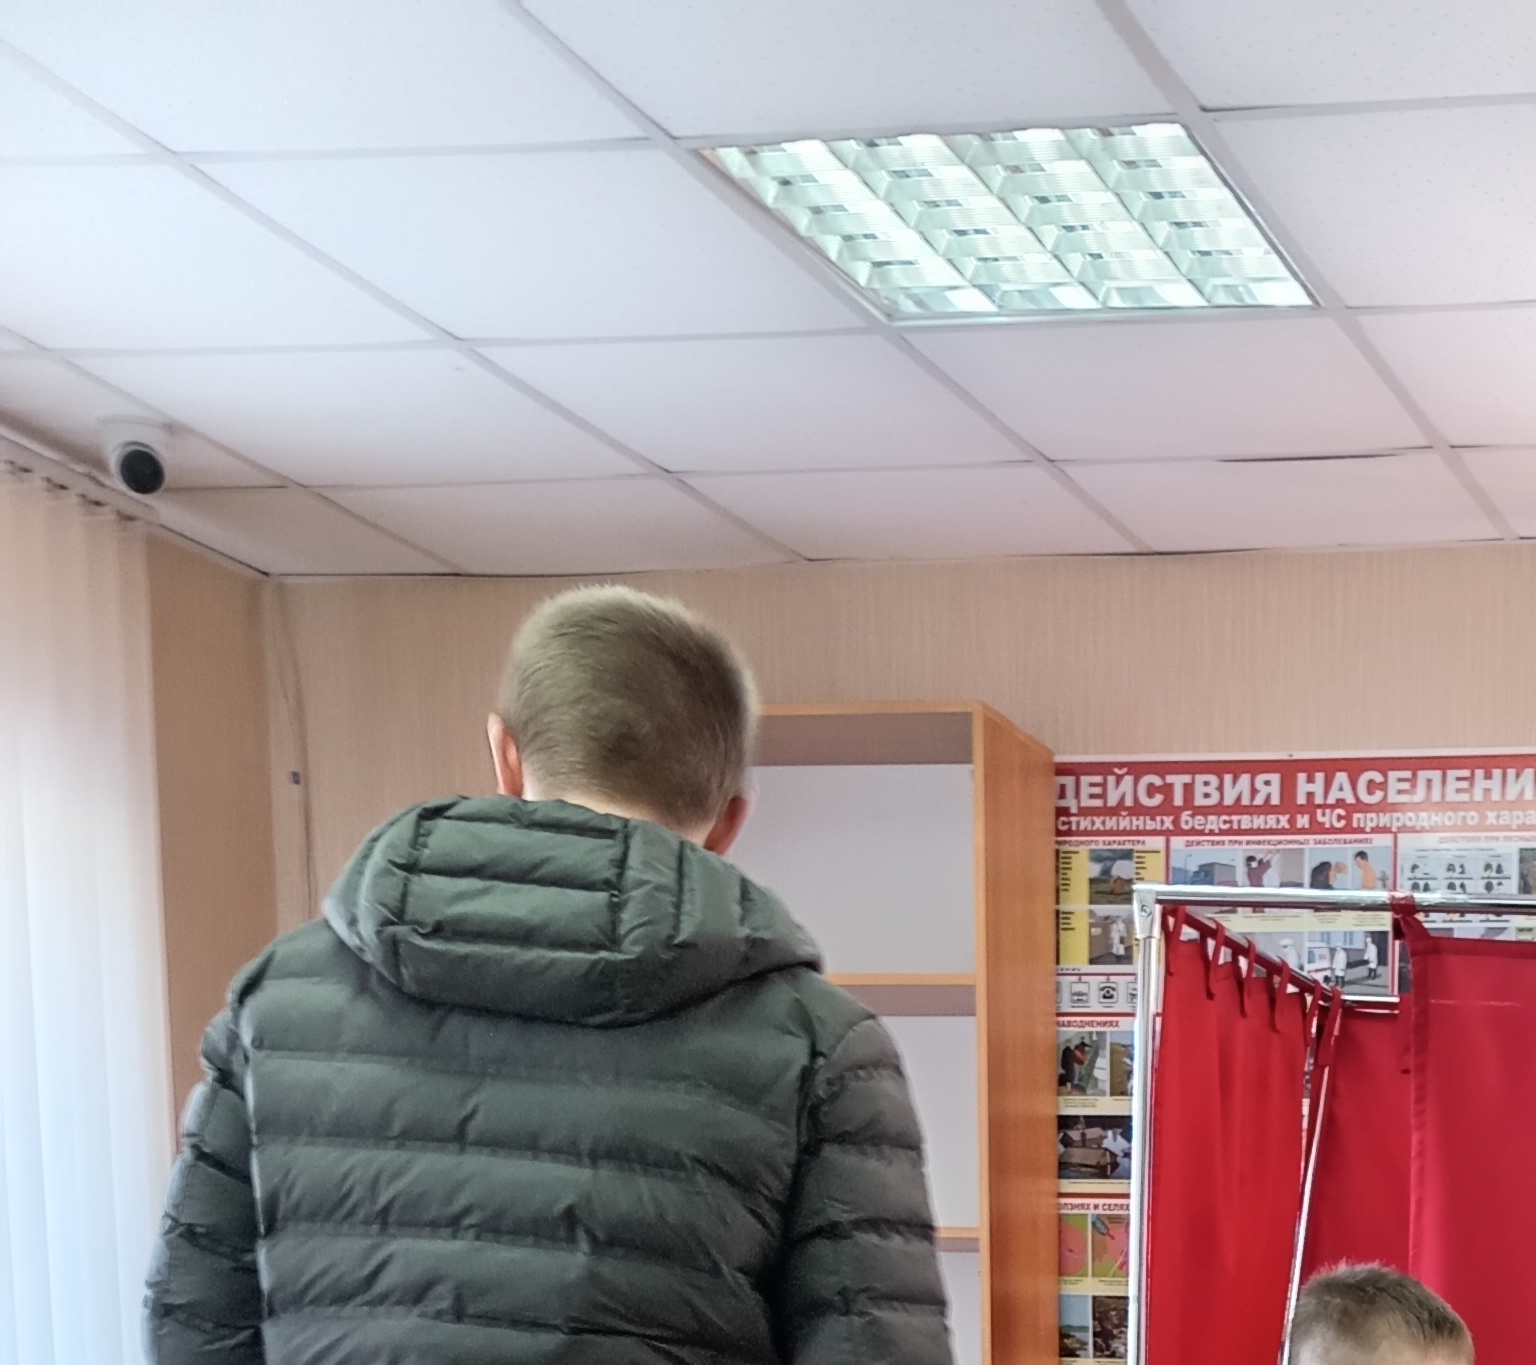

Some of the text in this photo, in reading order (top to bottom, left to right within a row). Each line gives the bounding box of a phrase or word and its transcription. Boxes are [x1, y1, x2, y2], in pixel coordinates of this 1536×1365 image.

[1055, 767, 1281, 813] ДЕЙСТВИЯ
[1057, 811, 1174, 831] стихийных
[1180, 811, 1290, 833] бедствиях
[1297, 814, 1310, 829] и
[1316, 809, 1347, 829] ЧС
[1352, 810, 1479, 832] природного
